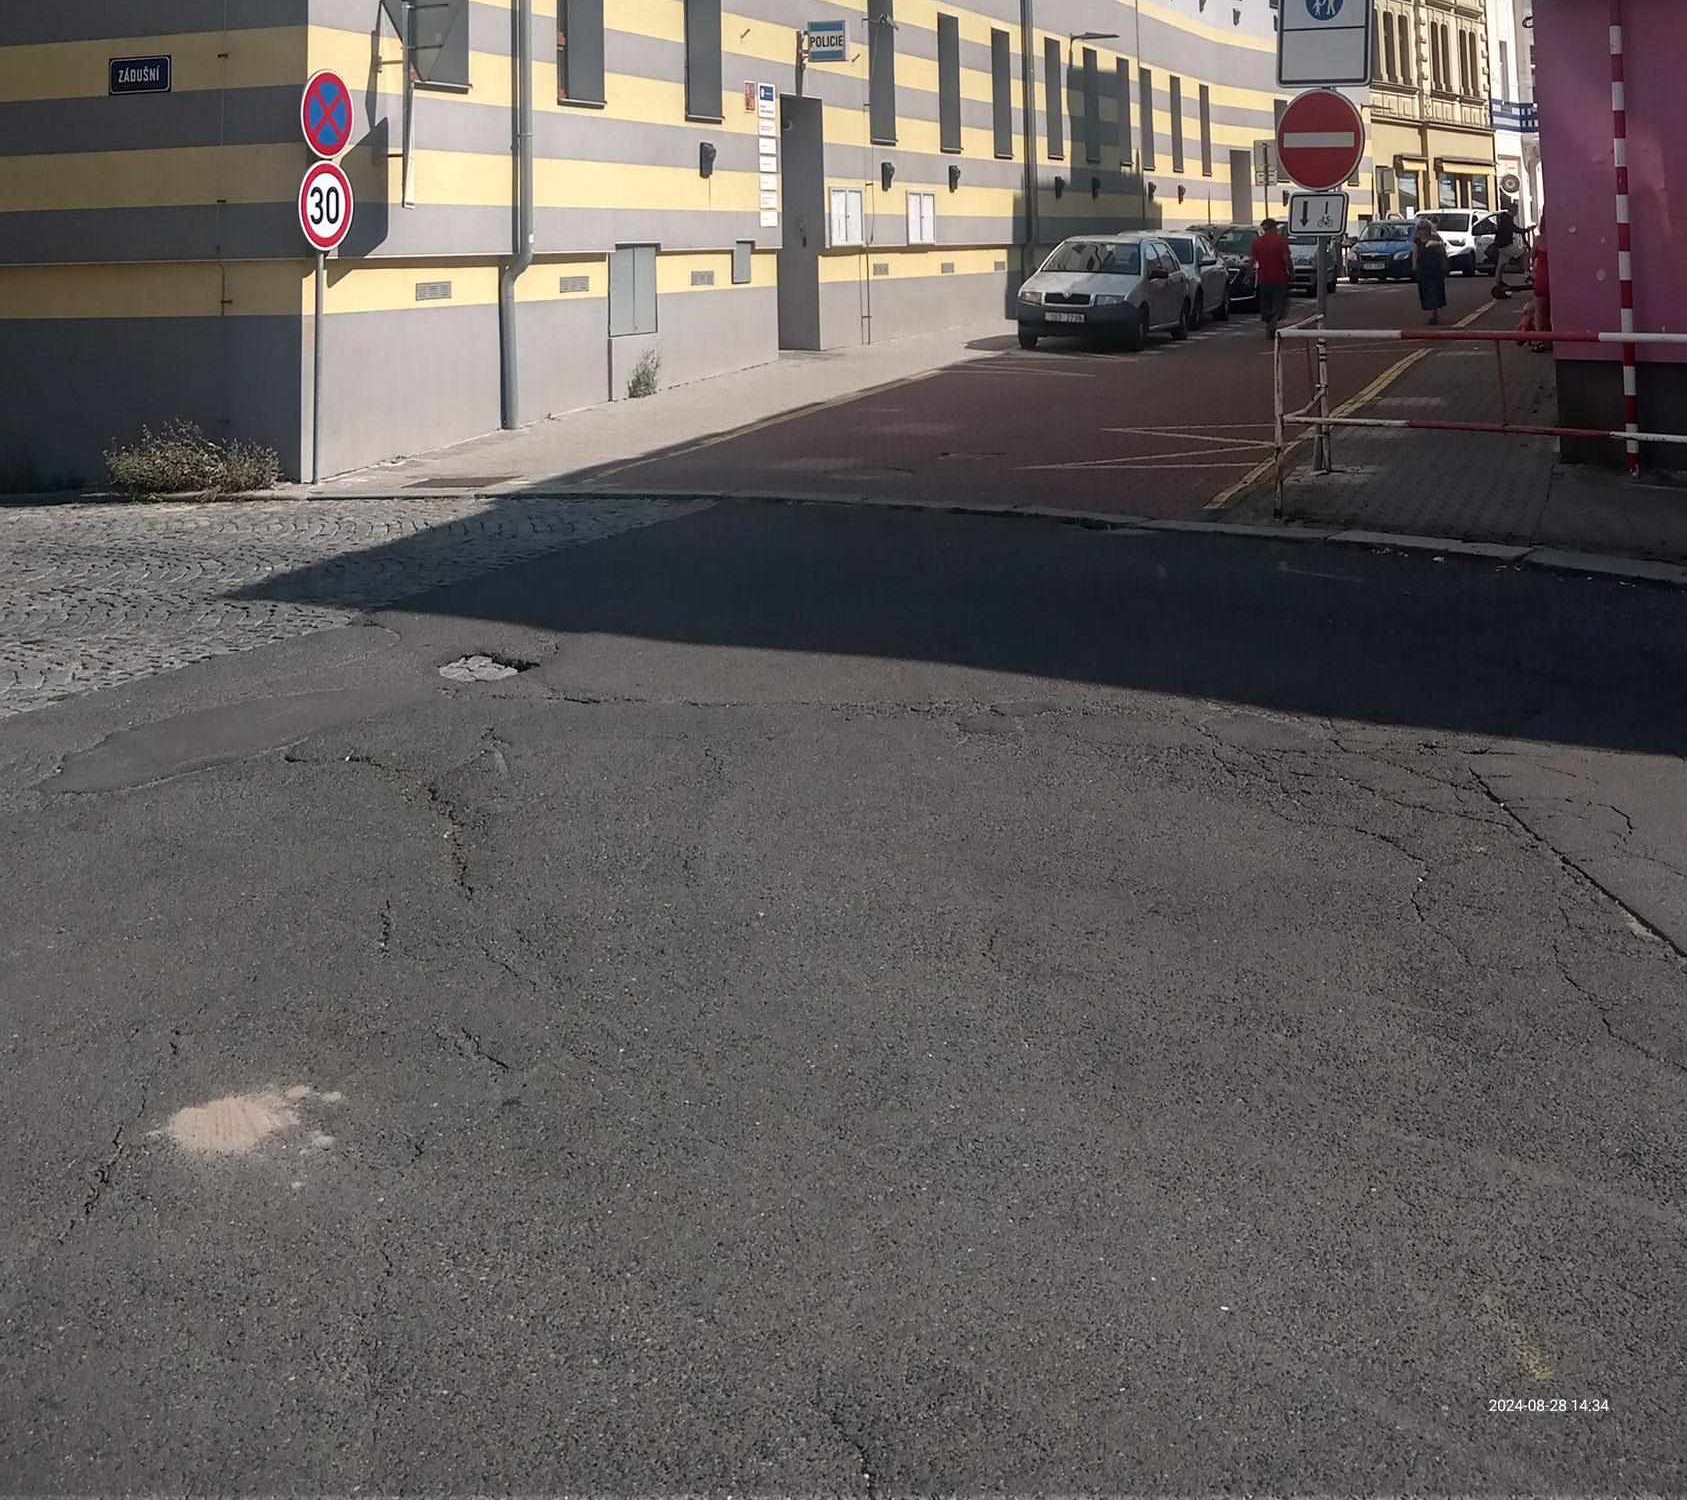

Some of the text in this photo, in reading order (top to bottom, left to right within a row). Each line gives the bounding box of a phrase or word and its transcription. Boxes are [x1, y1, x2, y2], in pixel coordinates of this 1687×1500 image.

[810, 35, 844, 47] POLICIE
[118, 65, 160, 83] ZÁDUŠNÍ
[310, 186, 339, 224] 30
